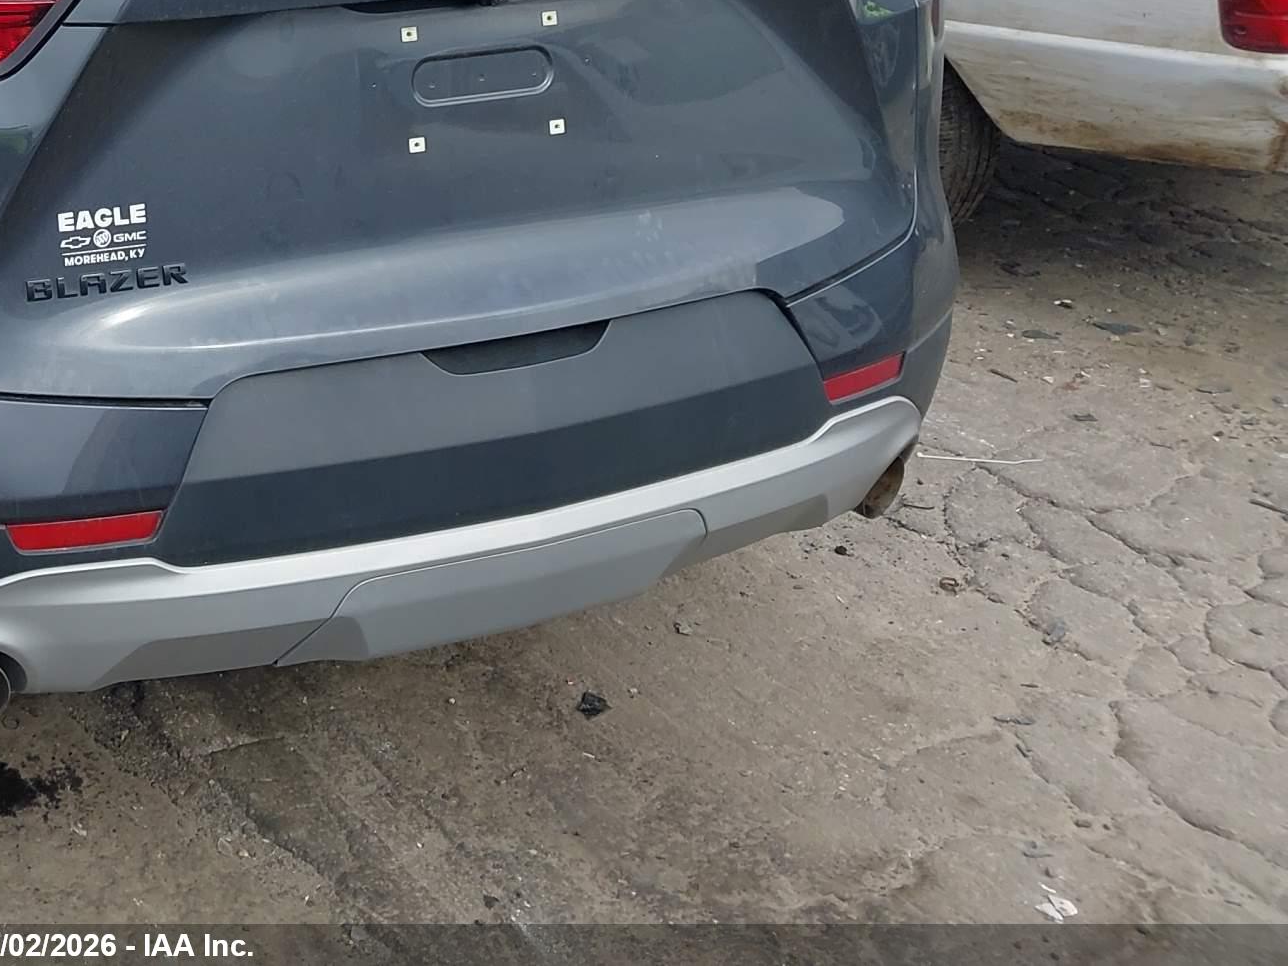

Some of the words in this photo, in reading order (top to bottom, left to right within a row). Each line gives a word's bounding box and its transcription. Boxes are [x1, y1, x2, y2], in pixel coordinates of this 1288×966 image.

[57, 203, 147, 233] EAGLE
[113, 230, 147, 243] GMC
[25, 262, 189, 302] BLAZER
